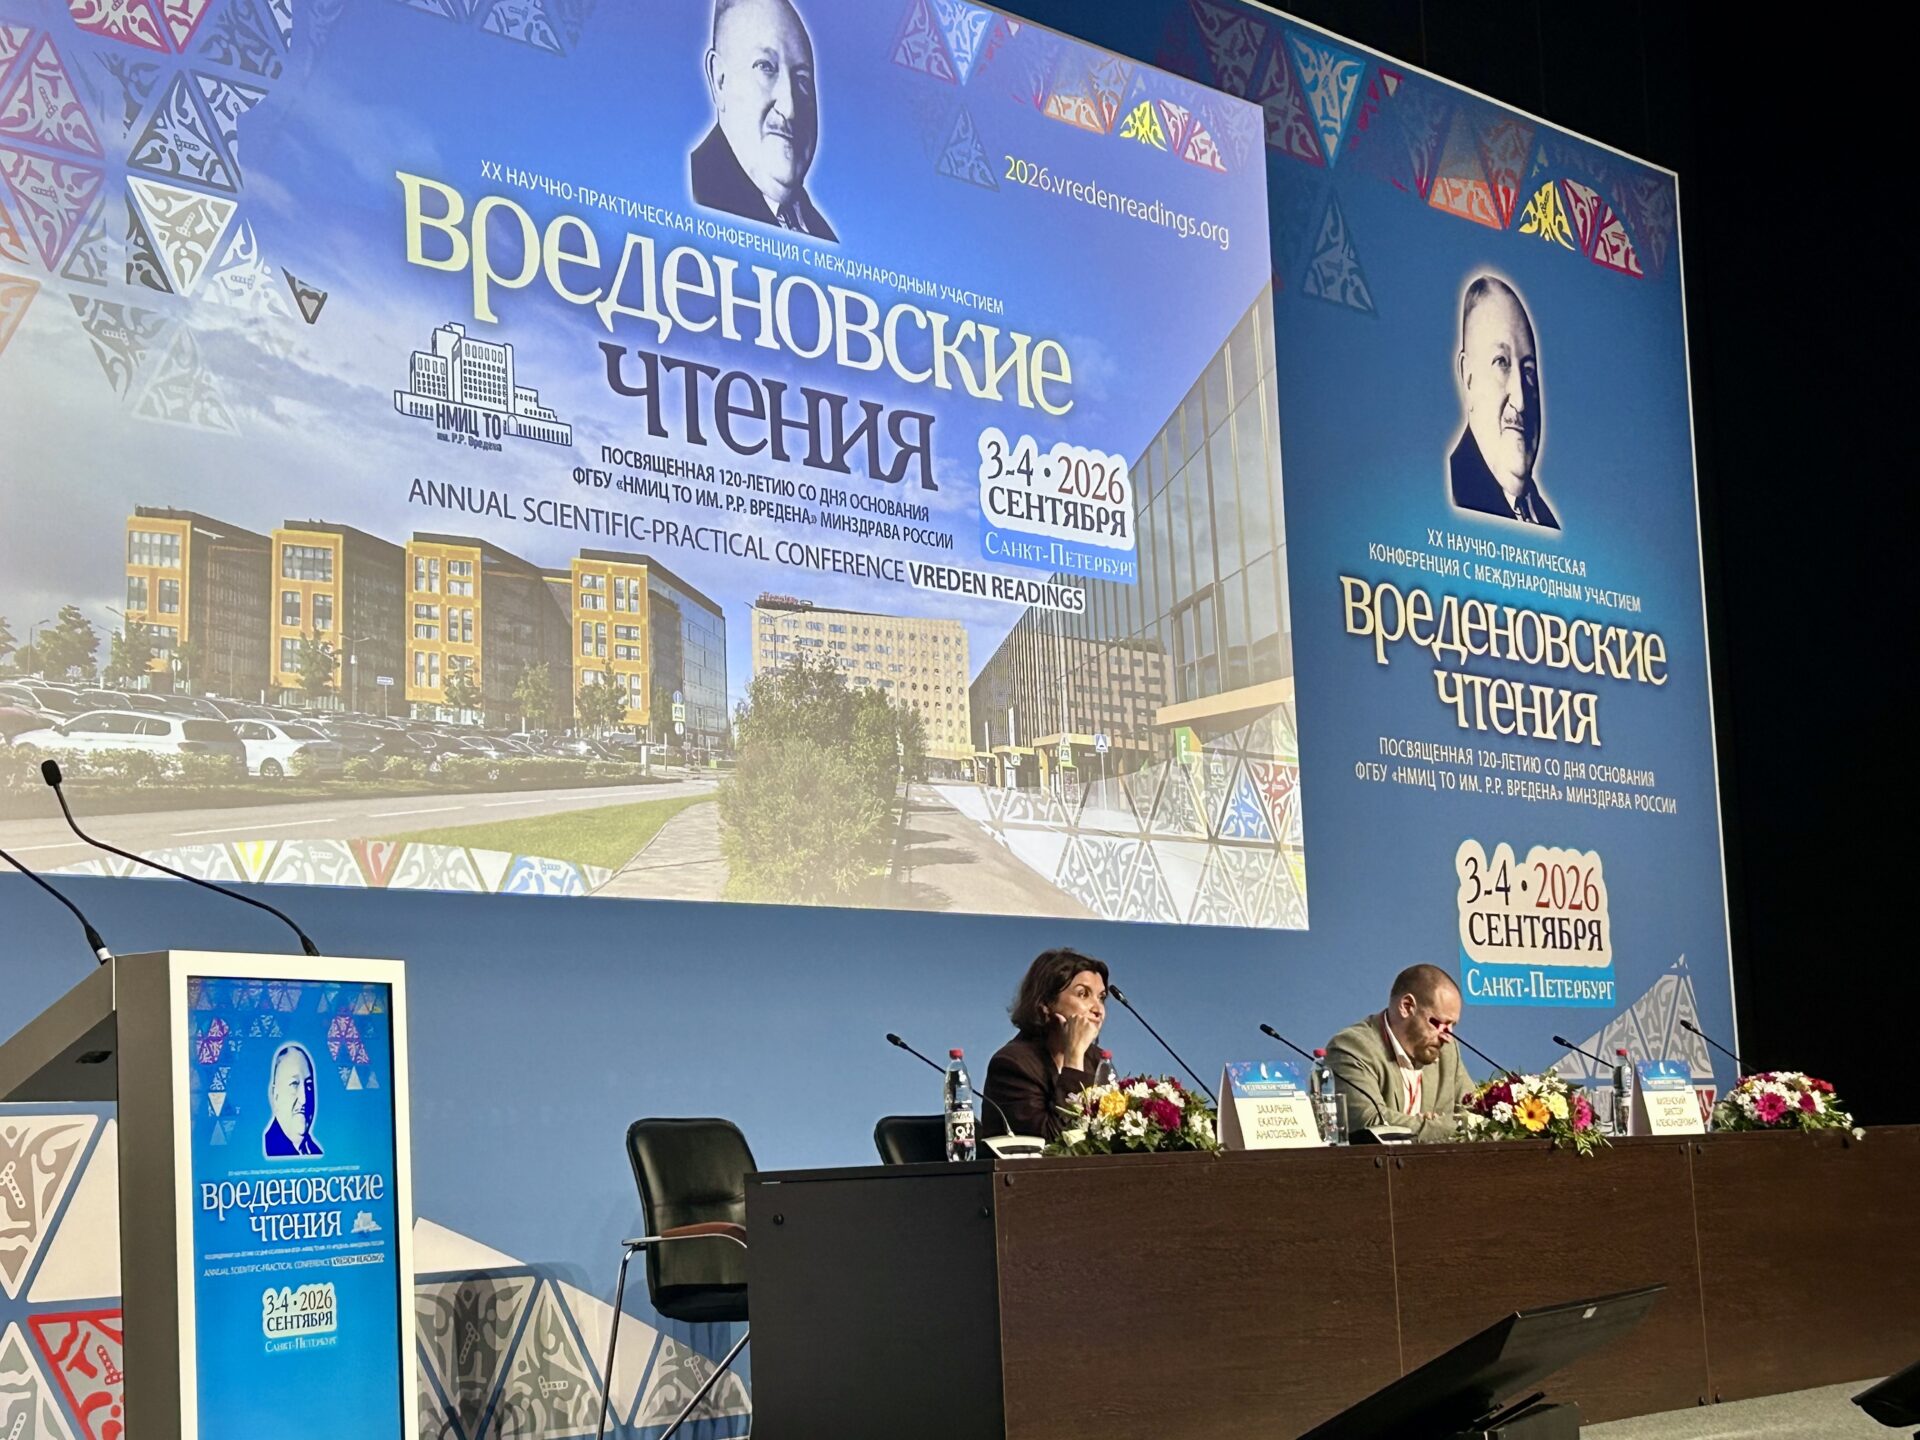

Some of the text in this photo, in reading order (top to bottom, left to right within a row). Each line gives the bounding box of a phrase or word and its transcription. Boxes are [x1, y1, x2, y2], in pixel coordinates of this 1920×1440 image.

[1004, 155, 1229, 250] 2026.vredenreadings.org
[506, 167, 693, 232] НАУЧНО-ПРАКТИЧЕСКАЯ
[697, 219, 799, 261] КОНФЕРЕНЦИЯ
[802, 248, 811, 265] С
[815, 252, 937, 297] МЕЖДУНАРОДНЫМ
[941, 284, 1004, 315] УЧАСТИЕМ
[436, 403, 502, 440] НМИЦ ТО
[601, 445, 929, 523] ПОСВЯЩЕННАЯ 120-ЛЕТИЮ СО ДНЯ ОСНОВАНИЯ
[1057, 455, 1125, 504] 2026
[573, 467, 953, 550] ФГБУ «НМИЦ ТО ИМ. Р.Р. ВРЕДЕНА» МИНЗДРАВА РОССИИ
[988, 486, 1127, 538] СЕНТЯБРЯ
[408, 478, 1084, 611] ANNUAL SCIENTIFIC-PRACTICAL CONFERENCE VREDEN READINGS
[1447, 533, 1587, 577] НАУЧНО-ПРАКТИЧЕСКАЯ
[1369, 542, 1641, 613] КОНФЕРЕНЦИЯ С МЕЖДУНАРОДНЫМ УЧАСТИЕМ
[1355, 762, 1677, 814] ФГБУ «НМИЦ ТО ИМ. Р.Р. ВРЕДЕНА» МИНЗДРАВА РОССИИ
[1380, 737, 1655, 788] ПОСВЯЩЕННАЯ 120-ЛЕТИЮ СО ДНЯ ОСНОВАНИЯ
[1534, 862, 1600, 911] 2026
[1468, 911, 1603, 952] СЕНТЯБРЯ
[266, 1311, 333, 1332] СЕНТЯБРЯ
[300, 1289, 333, 1312] 2026
